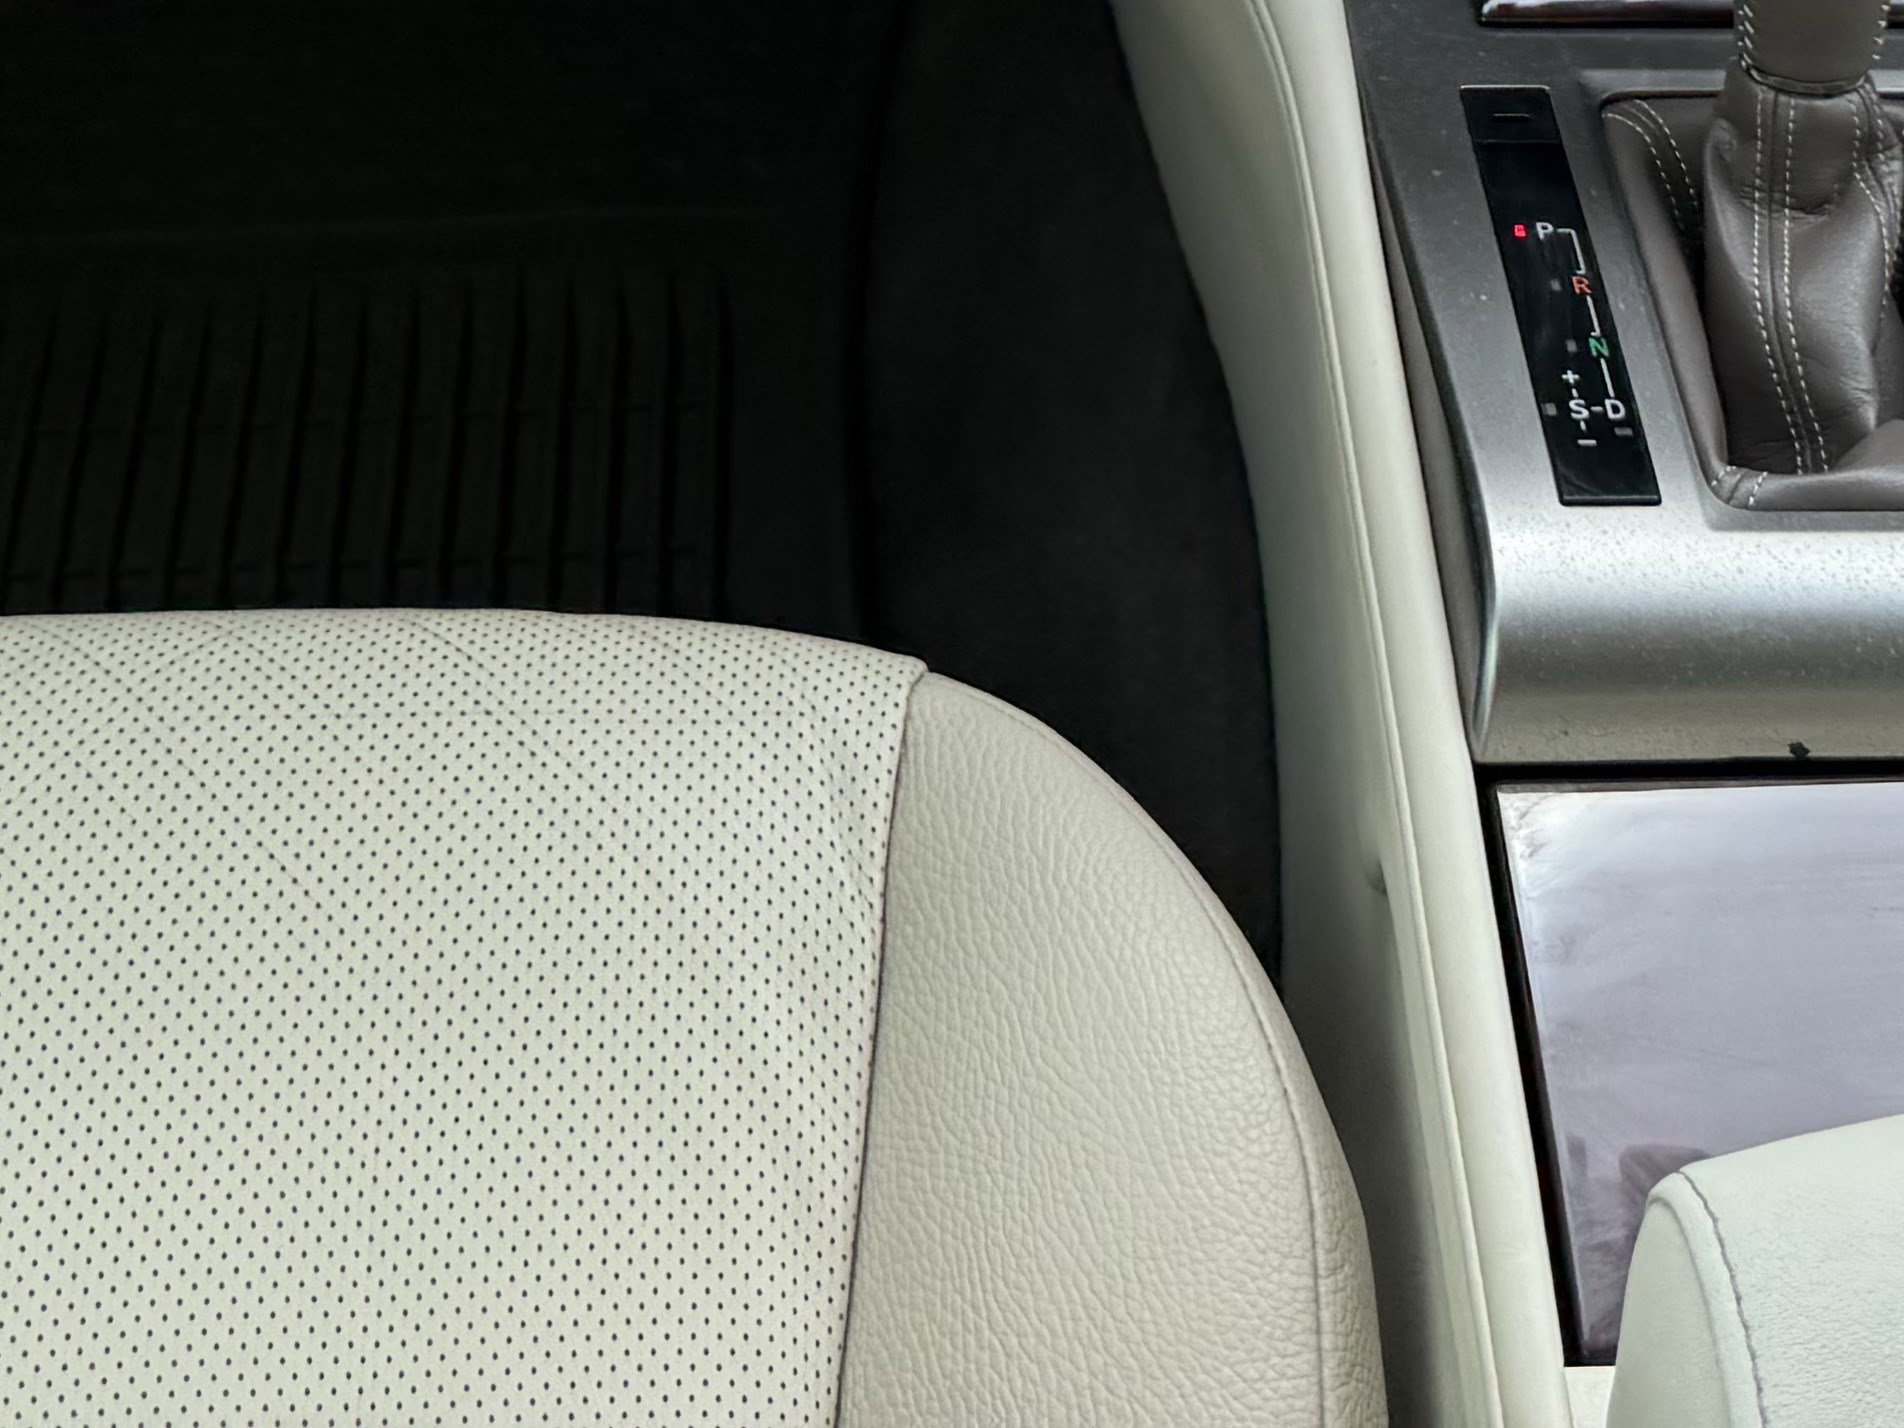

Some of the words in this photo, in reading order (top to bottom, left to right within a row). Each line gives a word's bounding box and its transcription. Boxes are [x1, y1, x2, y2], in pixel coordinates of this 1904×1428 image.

[1535, 221, 1554, 241] P
[1571, 275, 1593, 296] R
[1588, 336, 1611, 359] N
[1604, 398, 1626, 420] D
